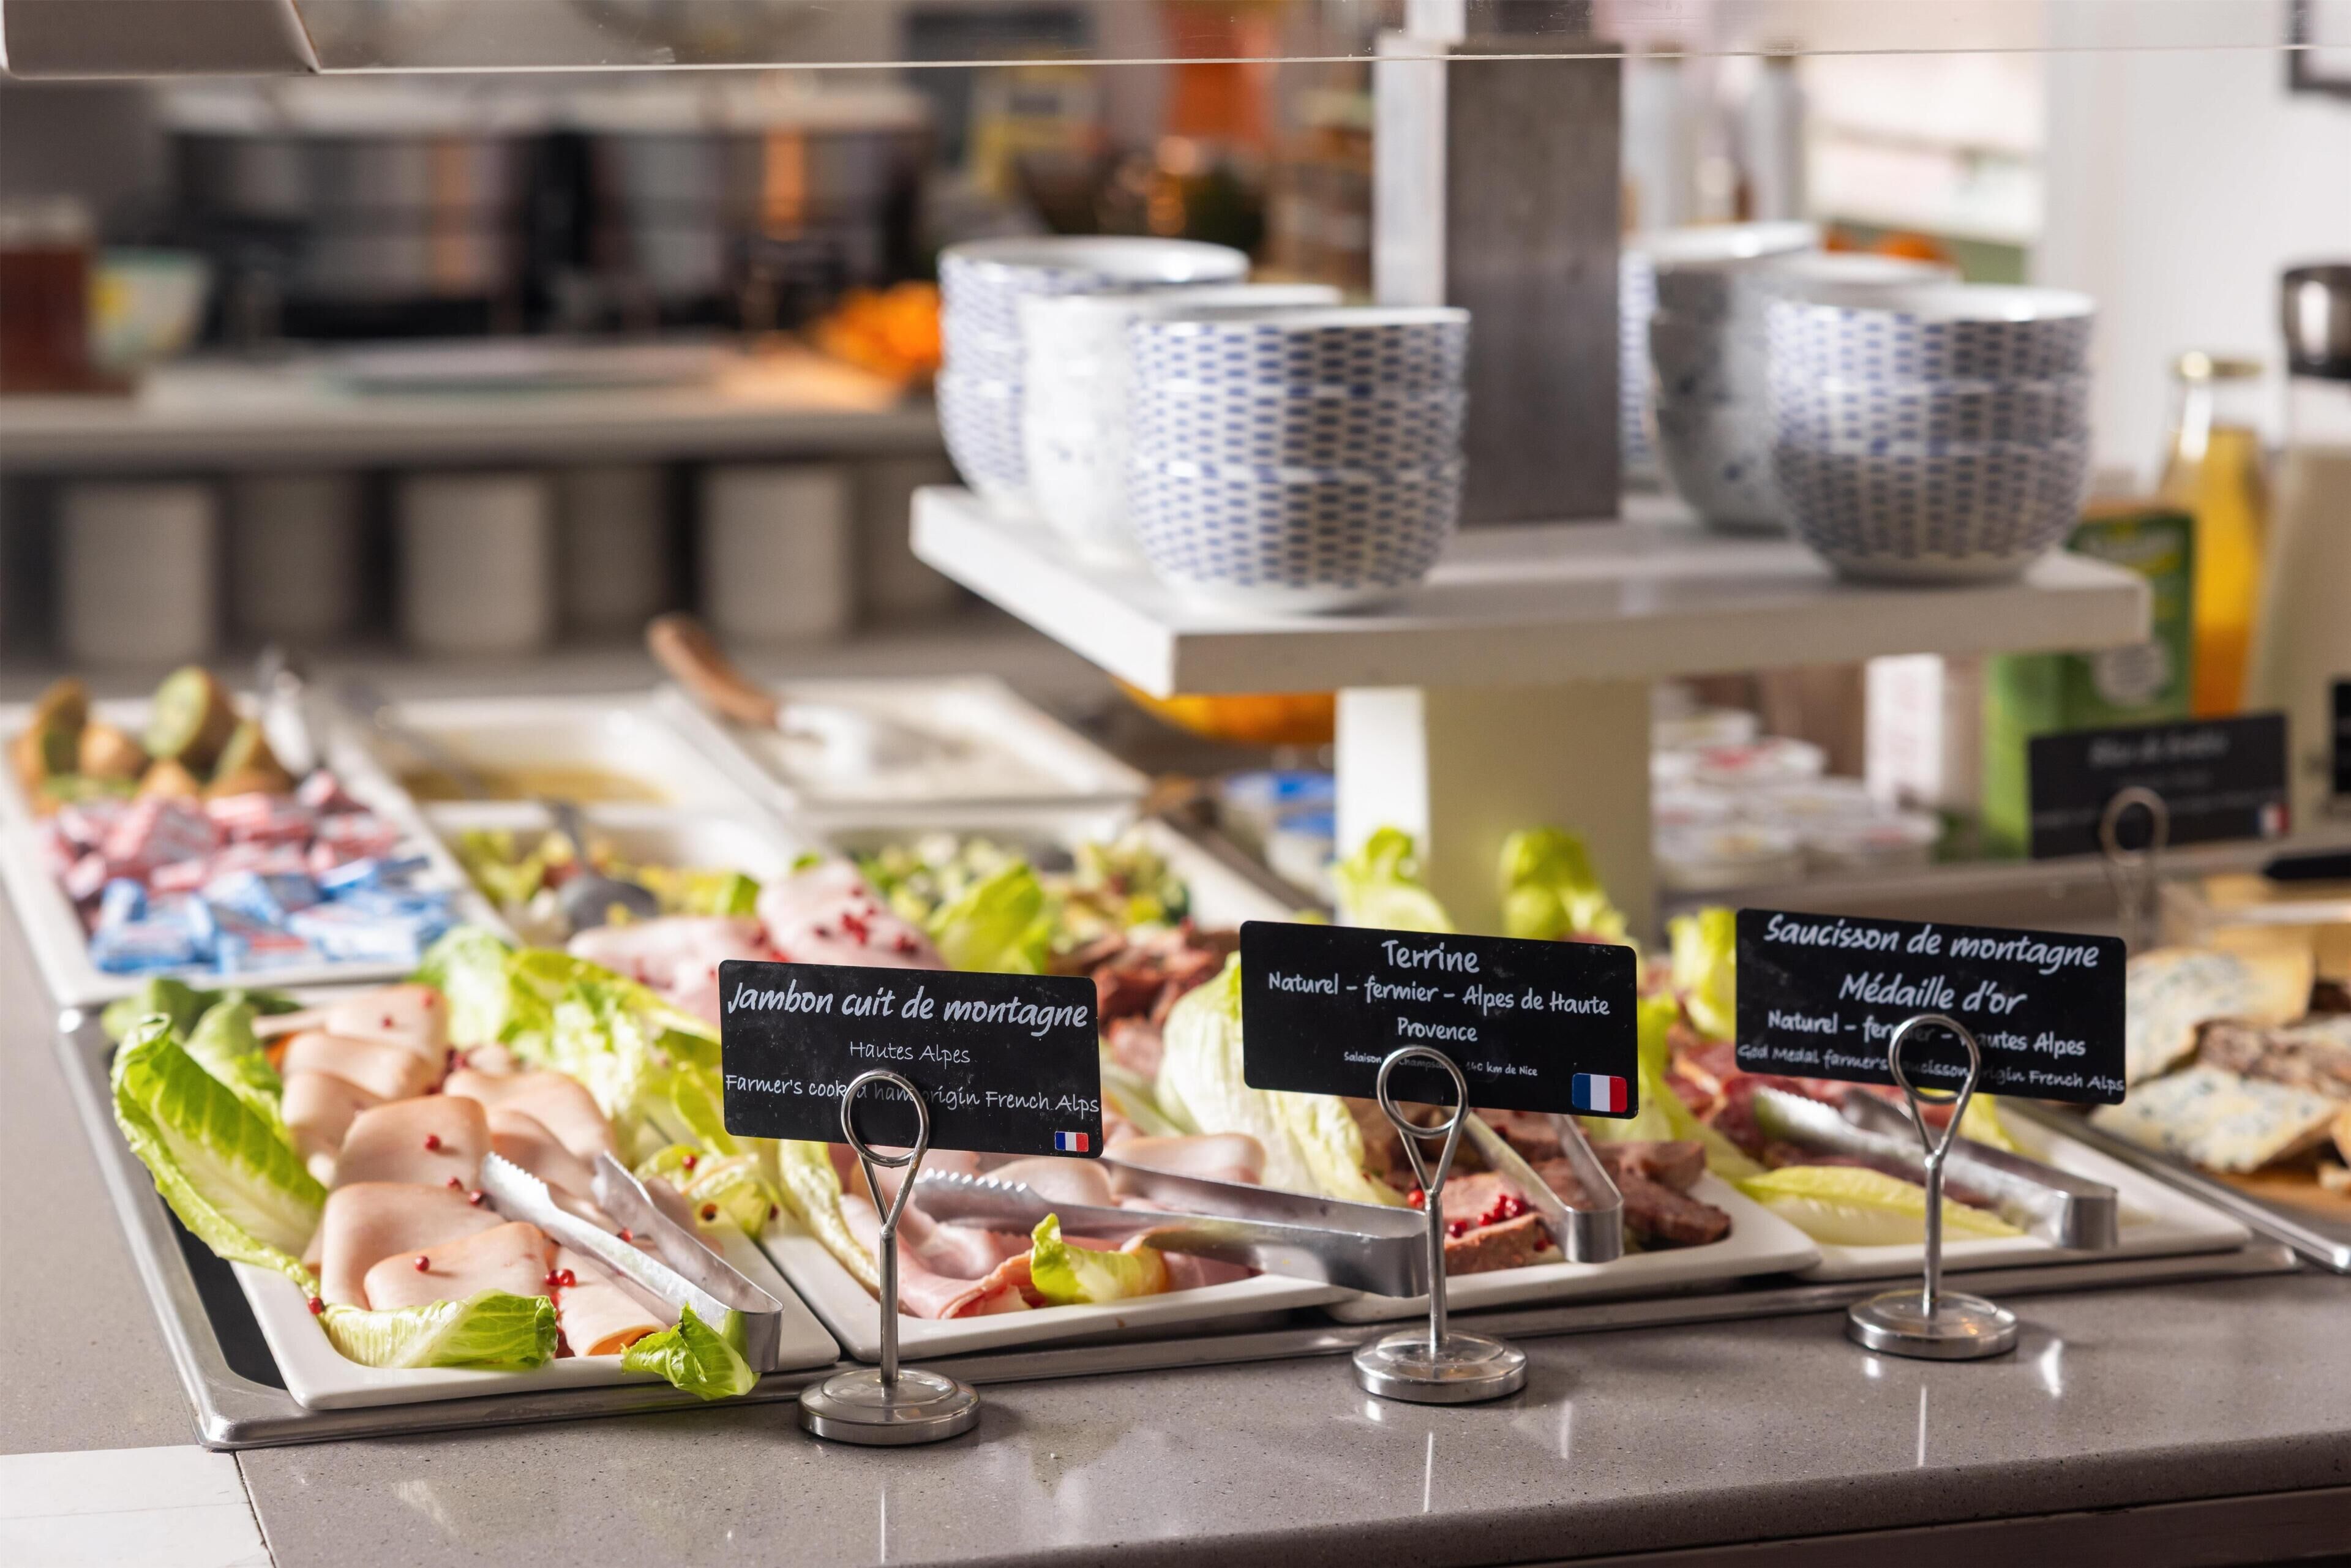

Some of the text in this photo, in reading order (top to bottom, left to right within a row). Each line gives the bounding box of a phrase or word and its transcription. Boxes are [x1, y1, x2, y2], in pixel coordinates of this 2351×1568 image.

[1381, 940, 1480, 974] Terrine
[1763, 914, 2099, 975] Saucisson de montagne
[728, 980, 1089, 1037] Jambon cuit de montagne
[1268, 971, 1340, 996] Naturel
[1363, 975, 1439, 1004] fermier
[1462, 983, 1515, 1016] Alpes
[1520, 987, 1545, 1012] de
[1549, 991, 1611, 1016] Haute
[1837, 971, 2027, 1015] Médaille d'or
[1397, 1016, 1479, 1043] Provence
[1768, 1010, 1839, 1035] Naturel
[2032, 1030, 2087, 1060] Alpes
[850, 1041, 971, 1070] Hautes Alpes
[1343, 1051, 1382, 1064] Salaison
[1487, 1061, 1503, 1075] km
[1505, 1063, 1517, 1075] de
[1518, 1065, 1539, 1077] Nice
[1771, 1045, 1821, 1065] Medal
[1897, 1058, 1970, 1078] aucisson
[2028, 1069, 2083, 1089] French
[2087, 1075, 2126, 1097] Alps
[726, 1075, 803, 1095] Farmer's
[808, 1079, 868, 1099] cookd
[874, 1082, 916, 1102] ham
[985, 1091, 1050, 1110] French
[1054, 1093, 1100, 1120] Alps
